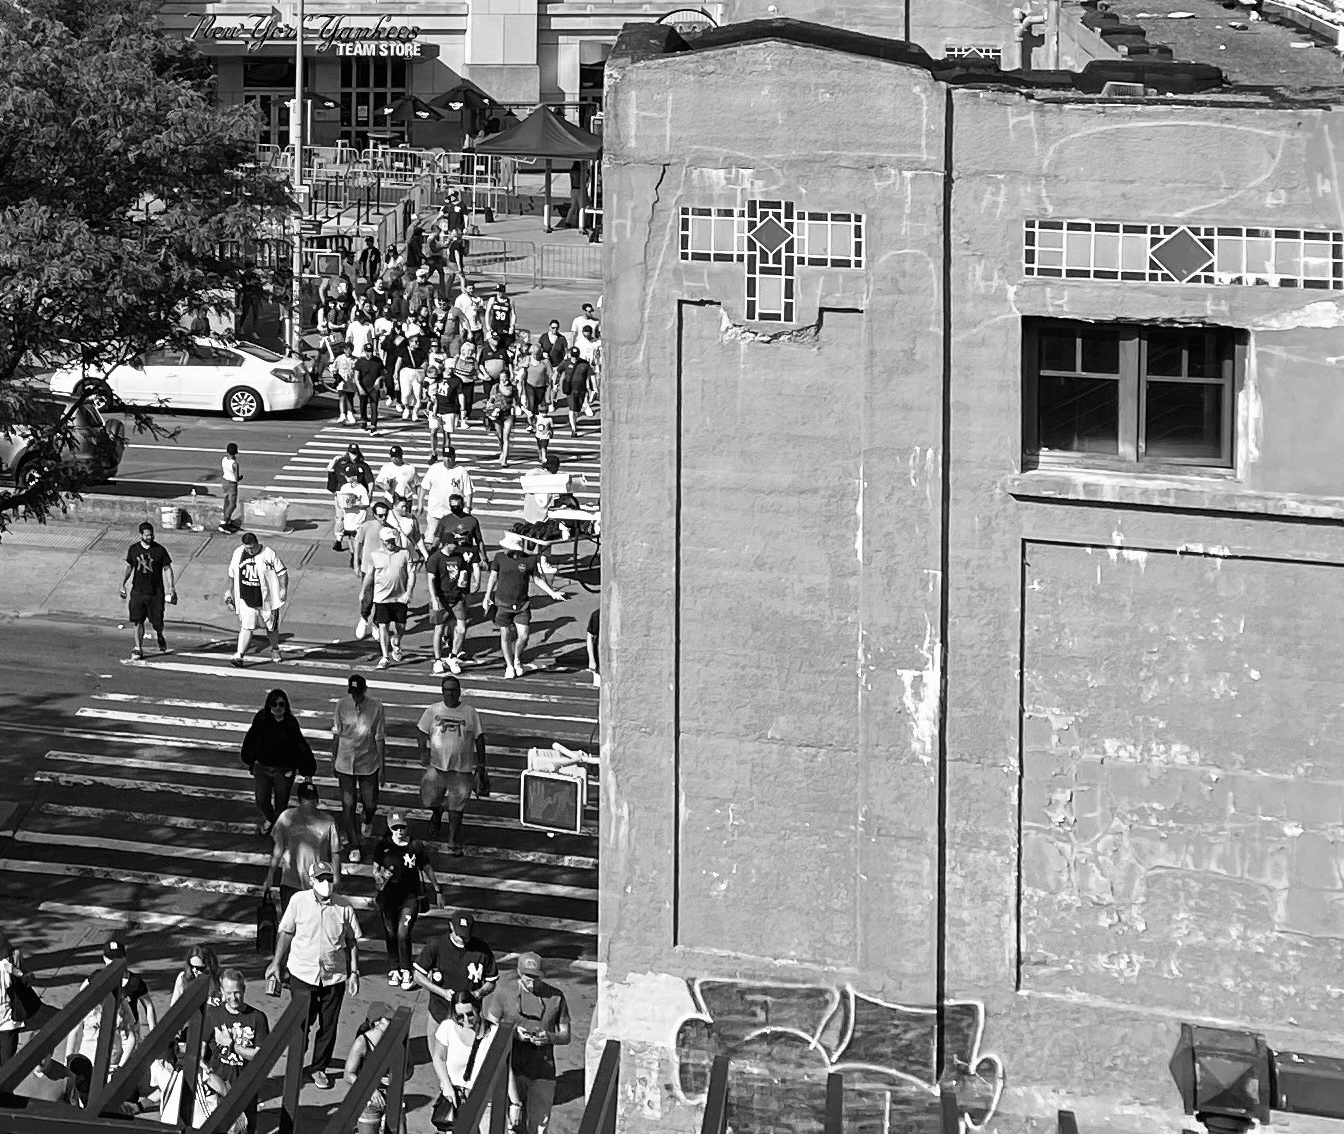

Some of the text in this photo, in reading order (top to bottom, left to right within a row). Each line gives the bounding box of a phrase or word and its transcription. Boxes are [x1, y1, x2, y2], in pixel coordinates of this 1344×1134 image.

[184, 12, 245, 41] New
[315, 13, 421, 54] Yankees
[336, 42, 421, 57] TEAM STORE
